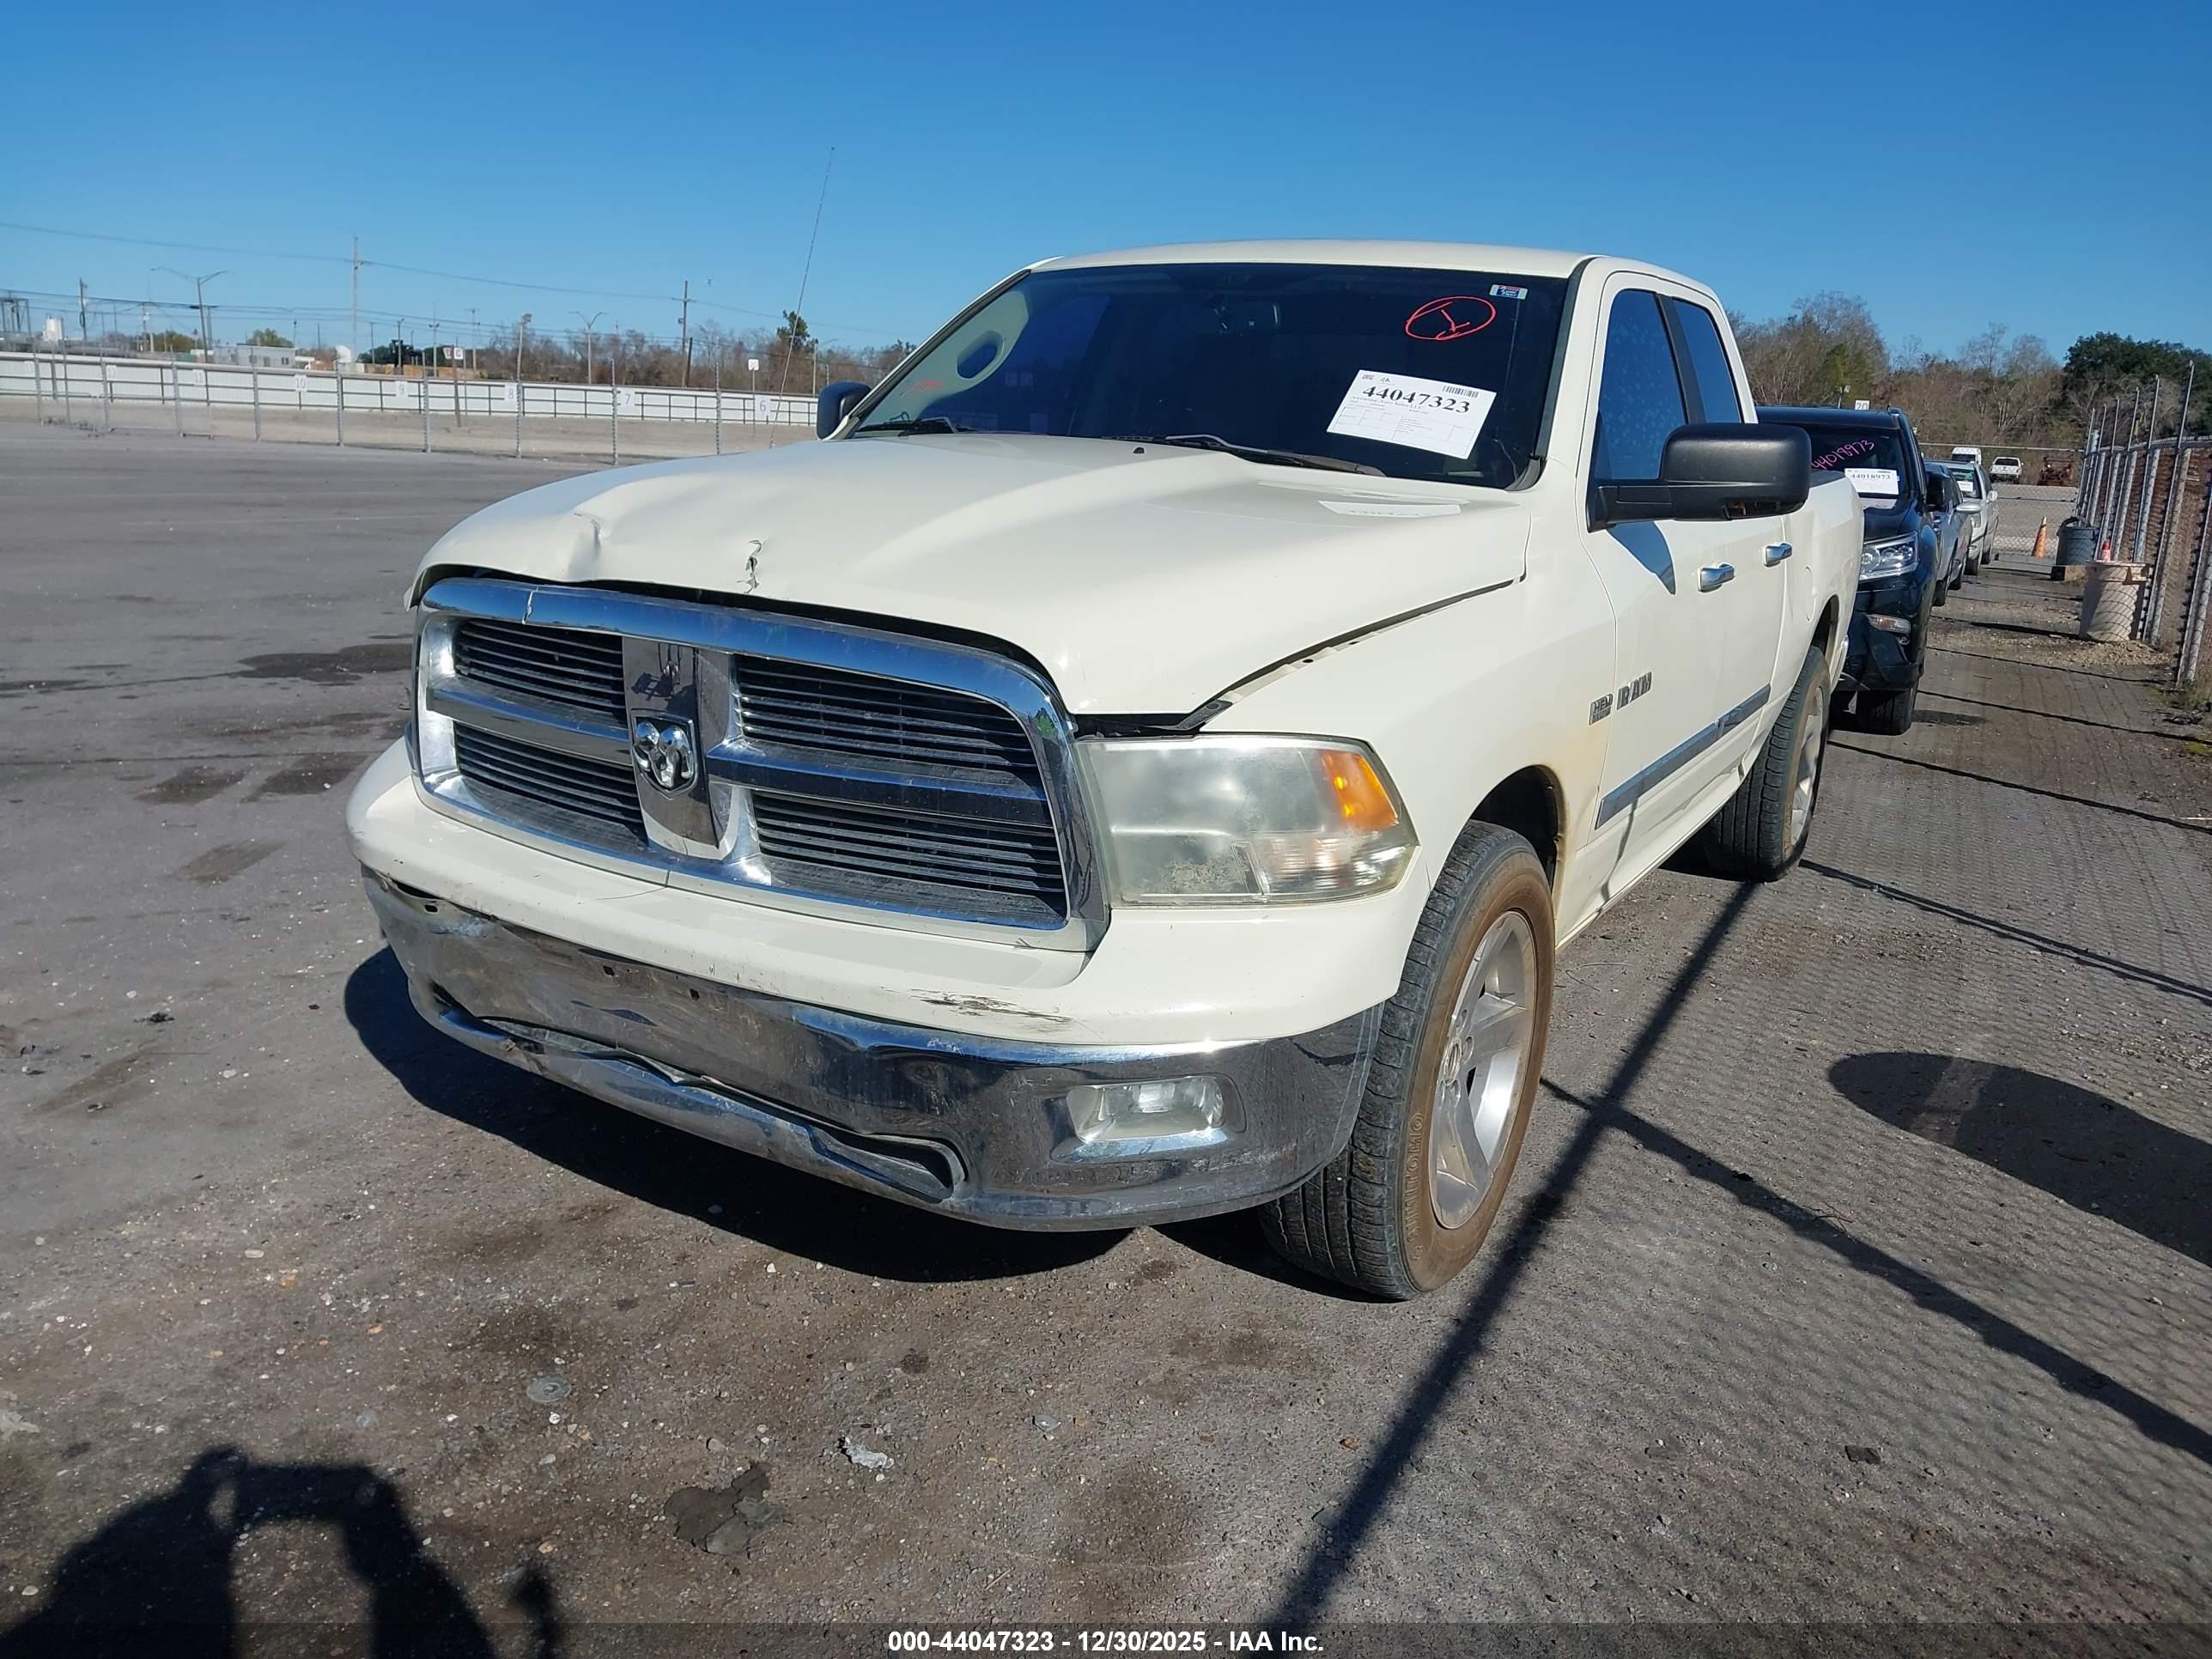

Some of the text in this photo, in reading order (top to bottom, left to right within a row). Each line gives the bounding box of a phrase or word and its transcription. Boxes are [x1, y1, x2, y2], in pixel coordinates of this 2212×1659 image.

[296, 378, 307, 389] 10
[398, 384, 404, 394] 9
[508, 388, 515, 399] 8
[625, 393, 632, 406] 7
[1363, 386, 1471, 413] 44047323
[759, 400, 767, 412] 6
[1856, 402, 1869, 410] 20
[1616, 672, 1652, 711] RAM
[1405, 1113, 1423, 1243] SUMITOMO
